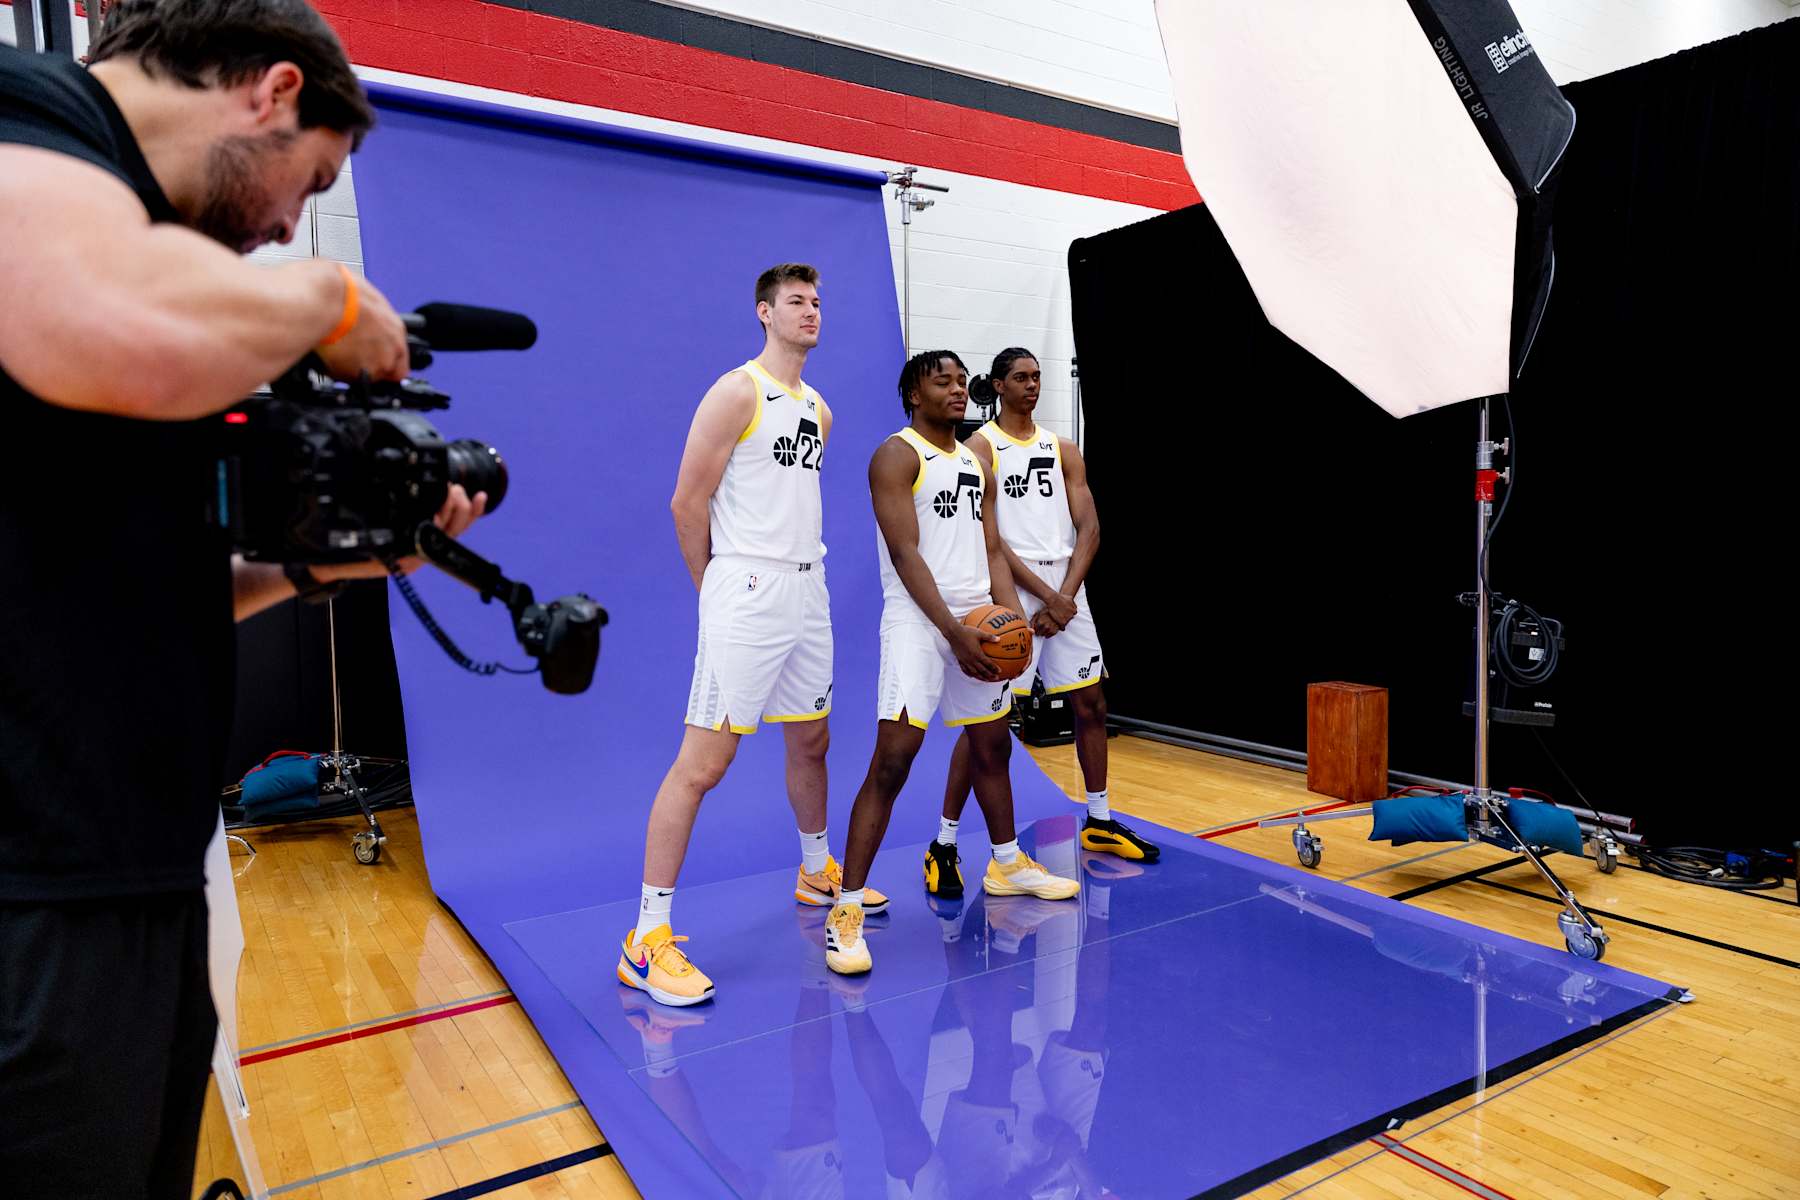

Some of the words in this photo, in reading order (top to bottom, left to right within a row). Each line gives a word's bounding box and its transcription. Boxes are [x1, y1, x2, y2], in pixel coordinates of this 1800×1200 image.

[1434, 36, 1474, 99] LIGHTING
[1471, 102, 1488, 119] JR
[801, 435, 823, 471] 22
[1037, 471, 1053, 498] 5
[967, 489, 983, 521] 13
